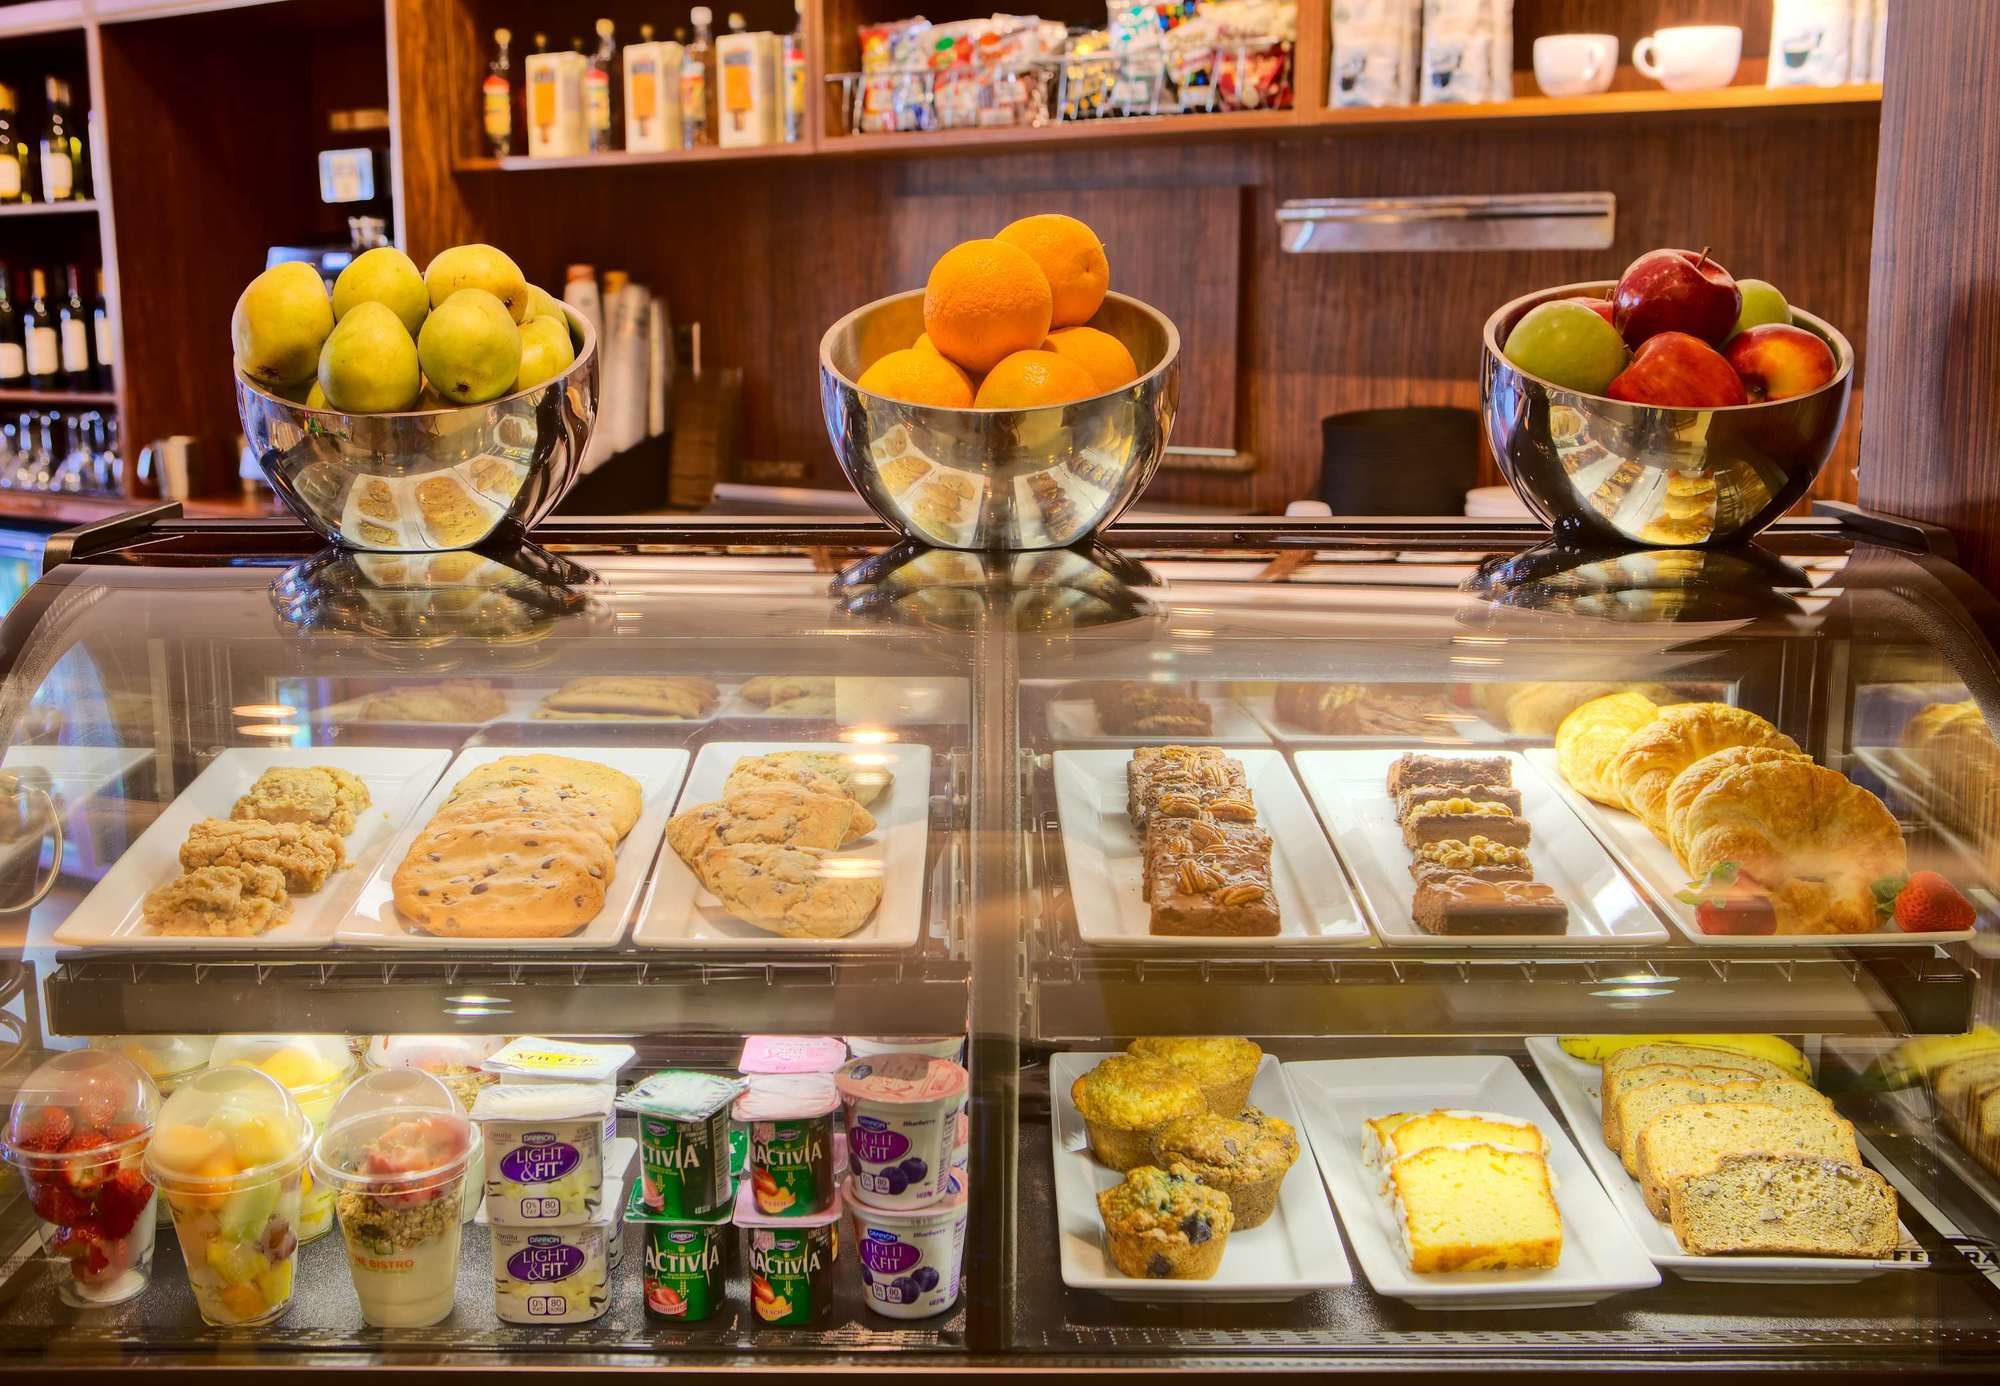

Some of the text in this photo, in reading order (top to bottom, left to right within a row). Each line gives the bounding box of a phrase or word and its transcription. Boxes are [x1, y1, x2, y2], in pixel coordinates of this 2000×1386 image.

[516, 1146, 564, 1164] LIGHT
[757, 1141, 822, 1166] ACTIVIA
[545, 1201, 556, 1209] 80
[368, 1259, 414, 1269] BISTRO
[523, 1248, 569, 1264] LIGHT
[645, 1245, 720, 1273] ACTIVIA
[756, 1251, 821, 1274] ACTIVIA
